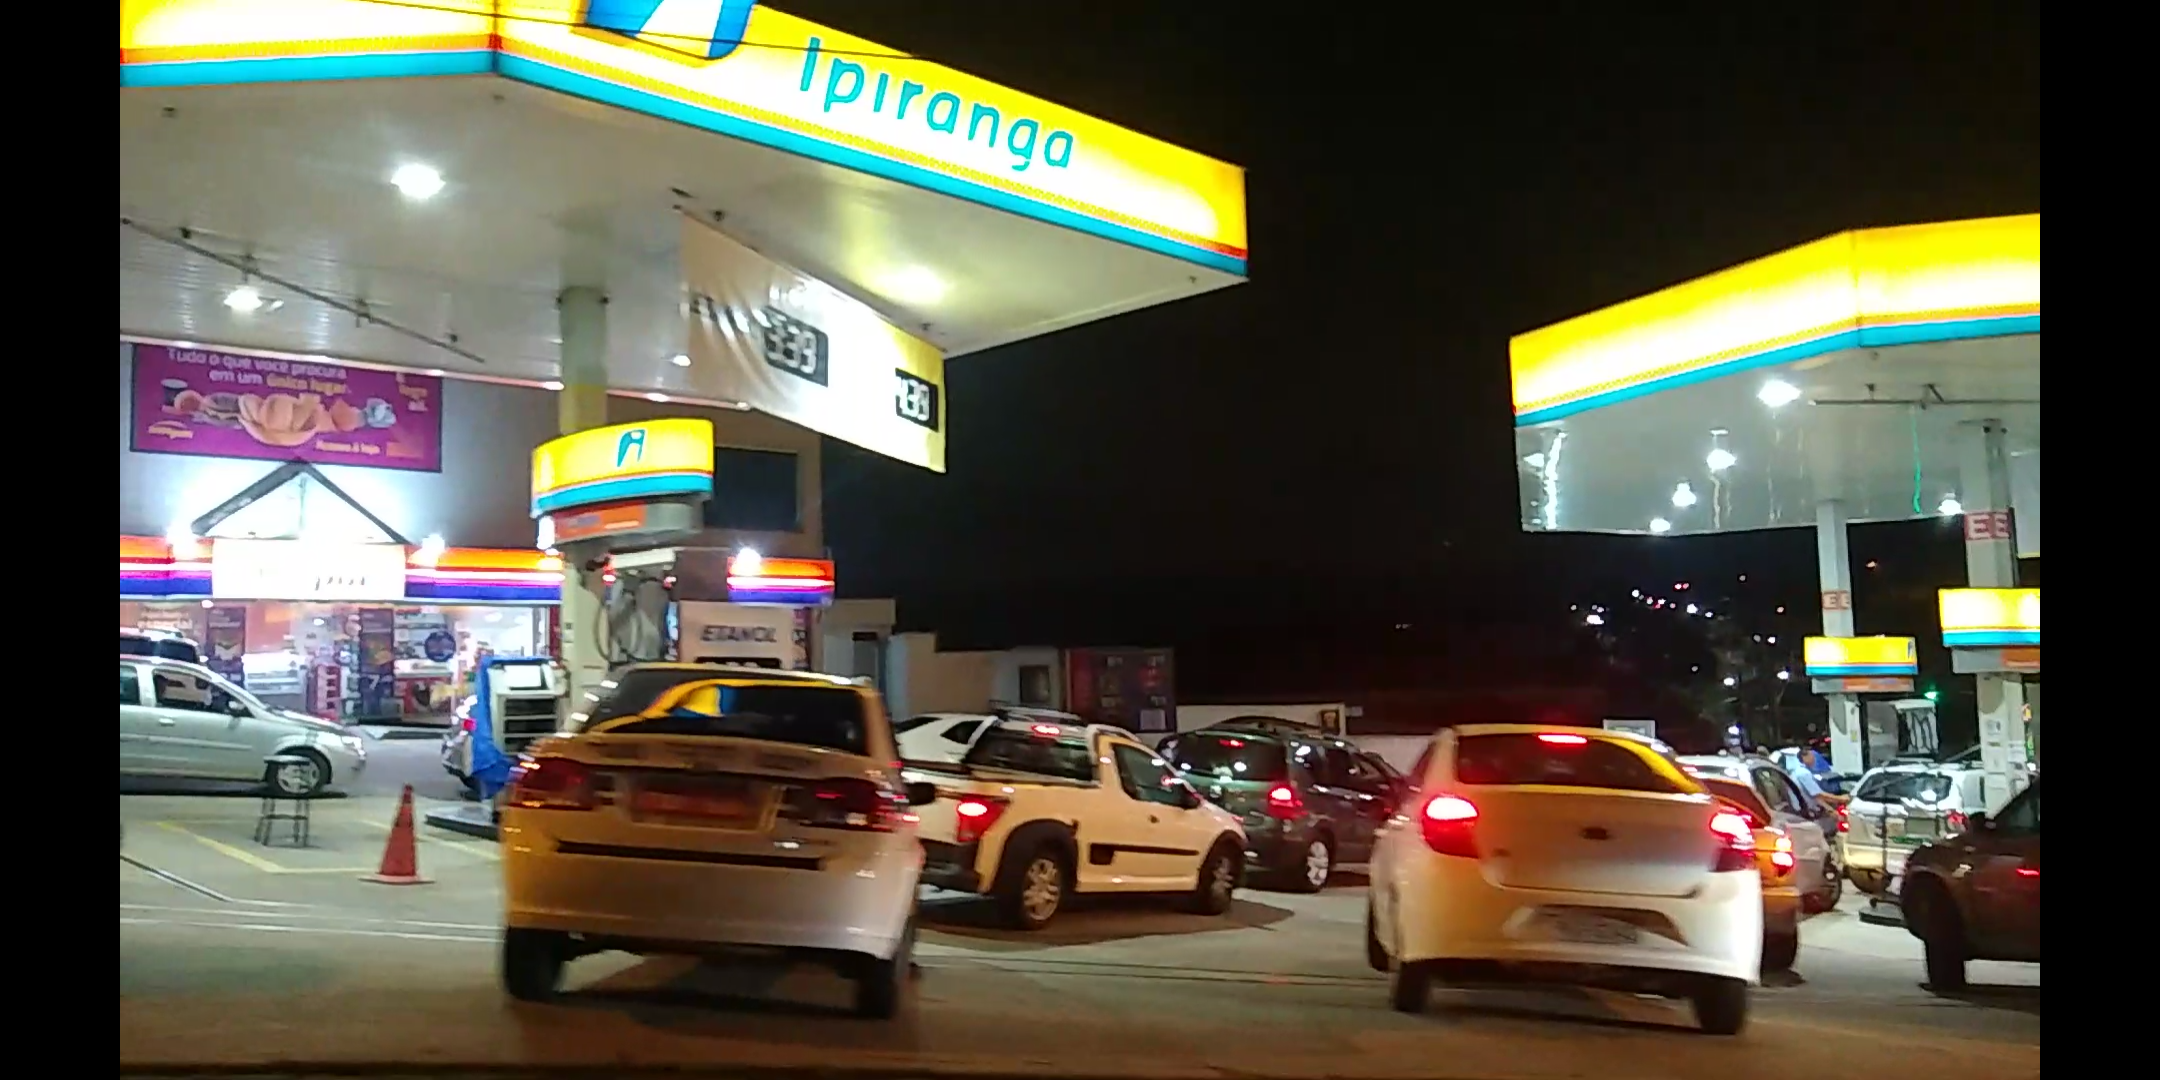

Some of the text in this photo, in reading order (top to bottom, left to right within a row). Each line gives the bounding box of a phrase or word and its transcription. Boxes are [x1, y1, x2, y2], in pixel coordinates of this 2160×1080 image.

[800, 37, 1074, 171] Ipiranga
[167, 347, 206, 365] Tudo
[222, 354, 252, 370] que
[208, 370, 236, 382] em
[236, 371, 264, 385] um
